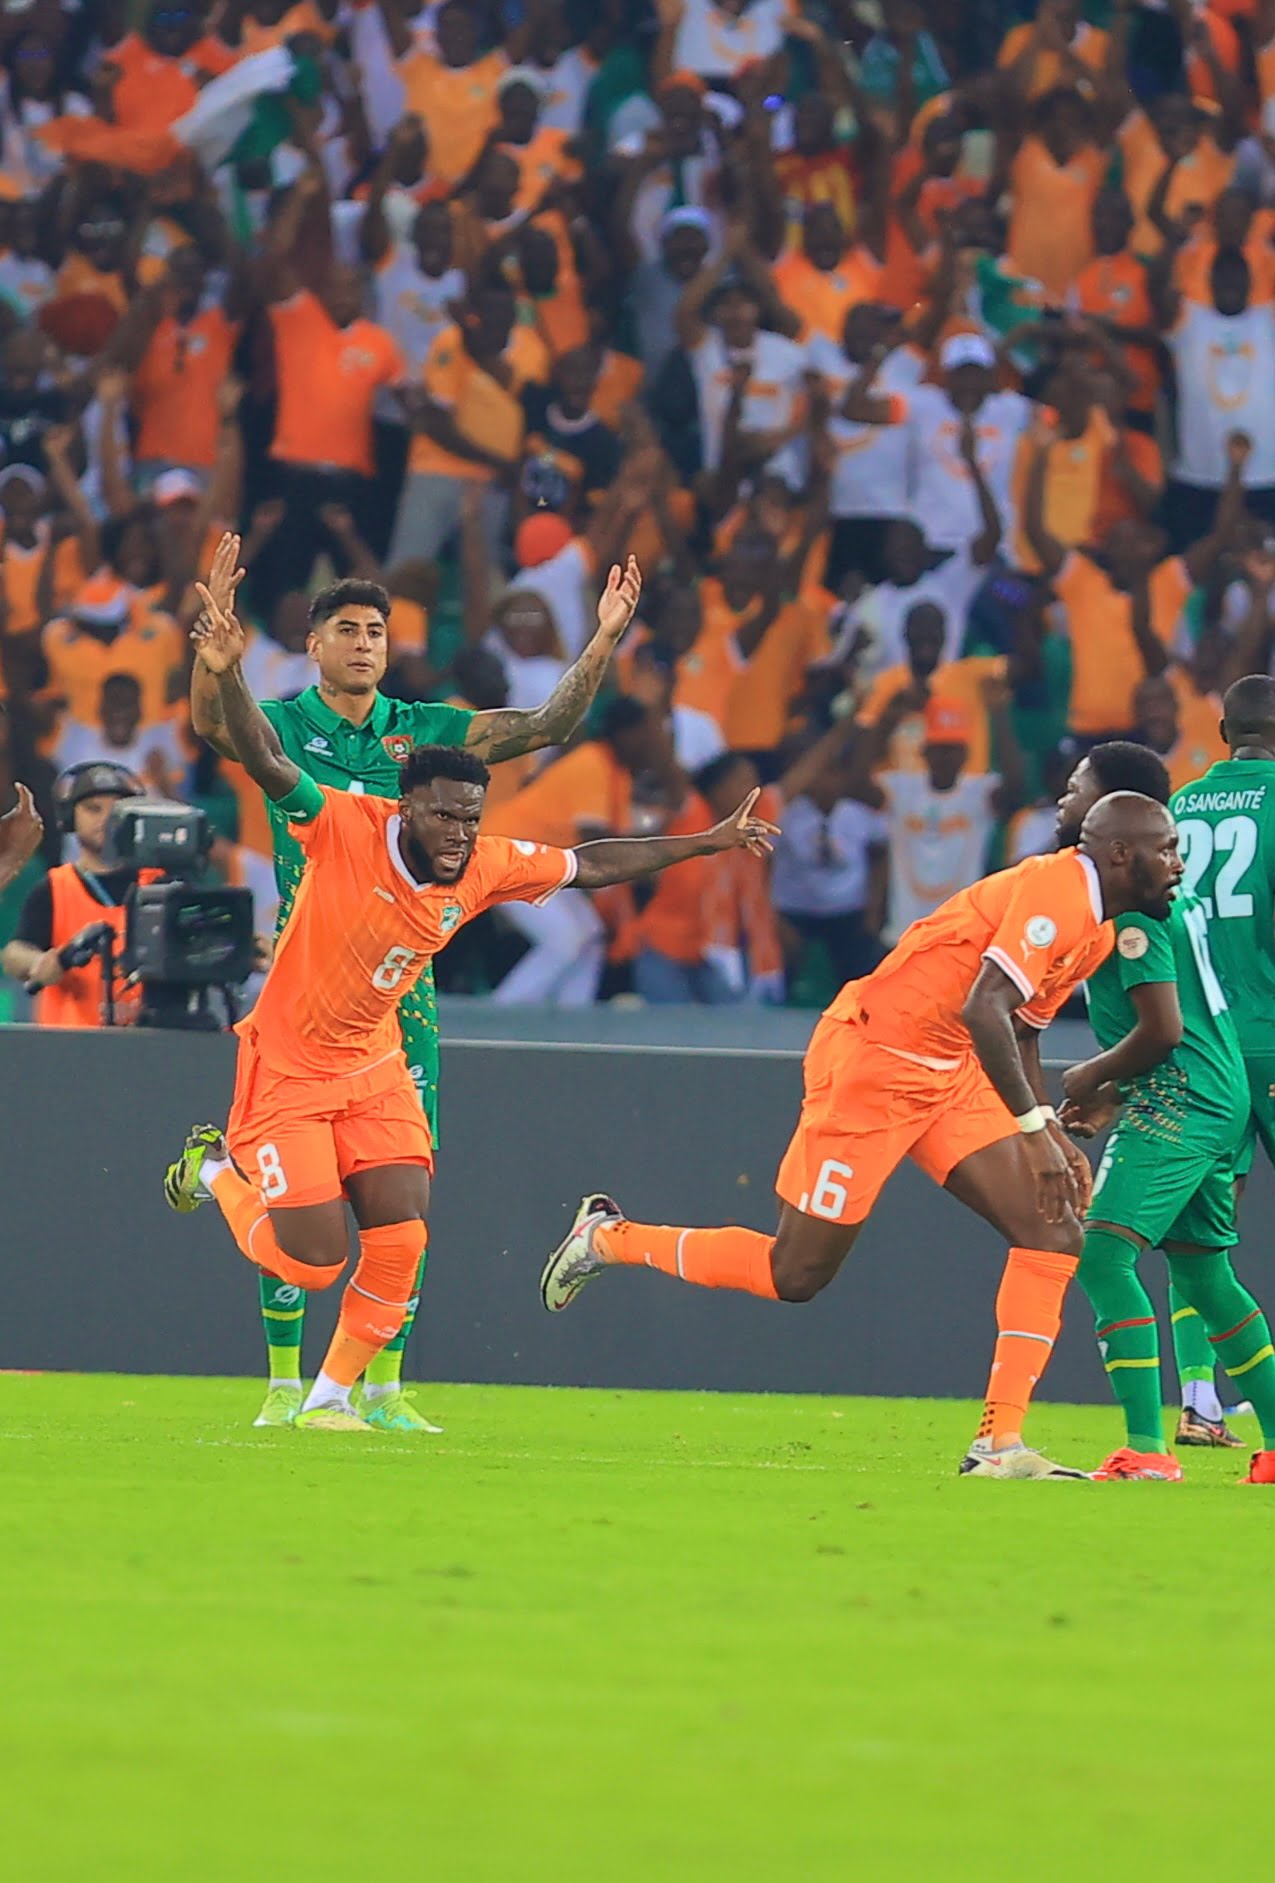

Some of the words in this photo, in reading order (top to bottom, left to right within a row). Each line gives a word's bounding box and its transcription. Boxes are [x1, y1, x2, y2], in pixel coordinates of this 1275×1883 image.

[1175, 815, 1258, 919] 22
[371, 945, 417, 990] 8
[256, 1143, 289, 1200] 8
[809, 1158, 854, 1219] 6
